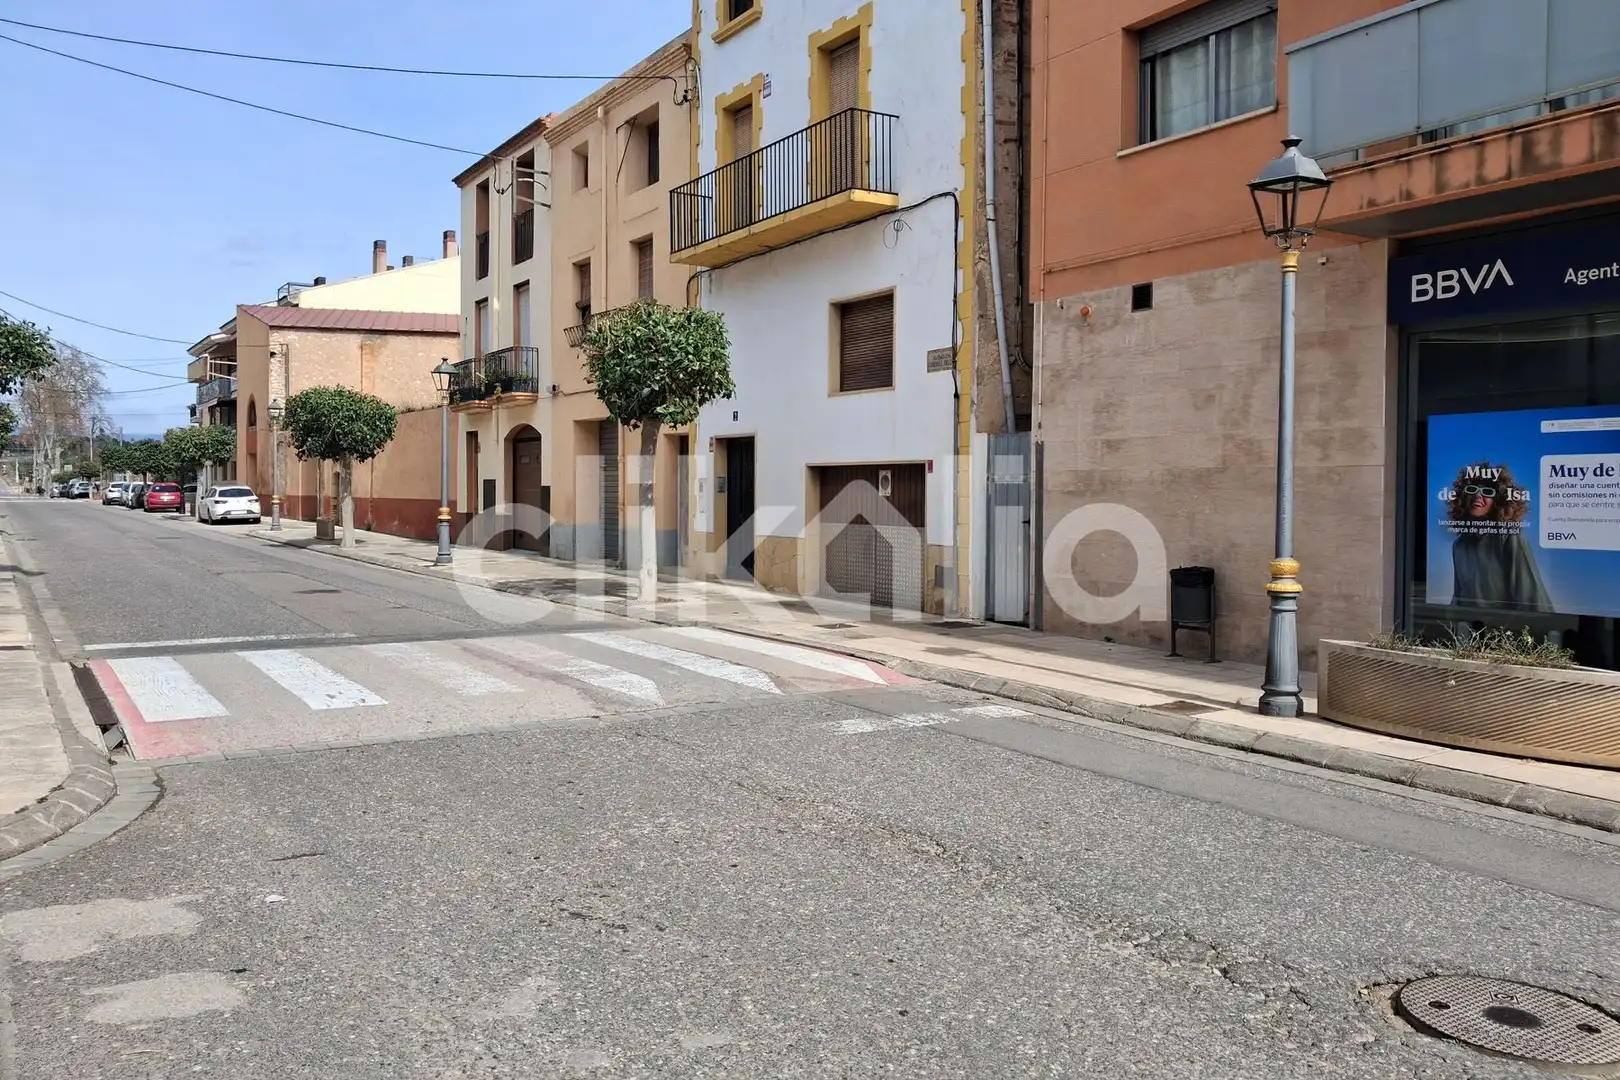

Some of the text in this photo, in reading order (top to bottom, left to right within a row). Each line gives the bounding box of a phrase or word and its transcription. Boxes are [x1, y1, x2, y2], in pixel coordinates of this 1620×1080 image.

[1411, 258, 1620, 303] BBVA Agent
[1464, 465, 1502, 481] Muy
[1549, 462, 1615, 481] Muy de
[1438, 486, 1531, 501] de Isa
[1478, 527, 1498, 535] gafas
[1547, 532, 1577, 541] BBVA
